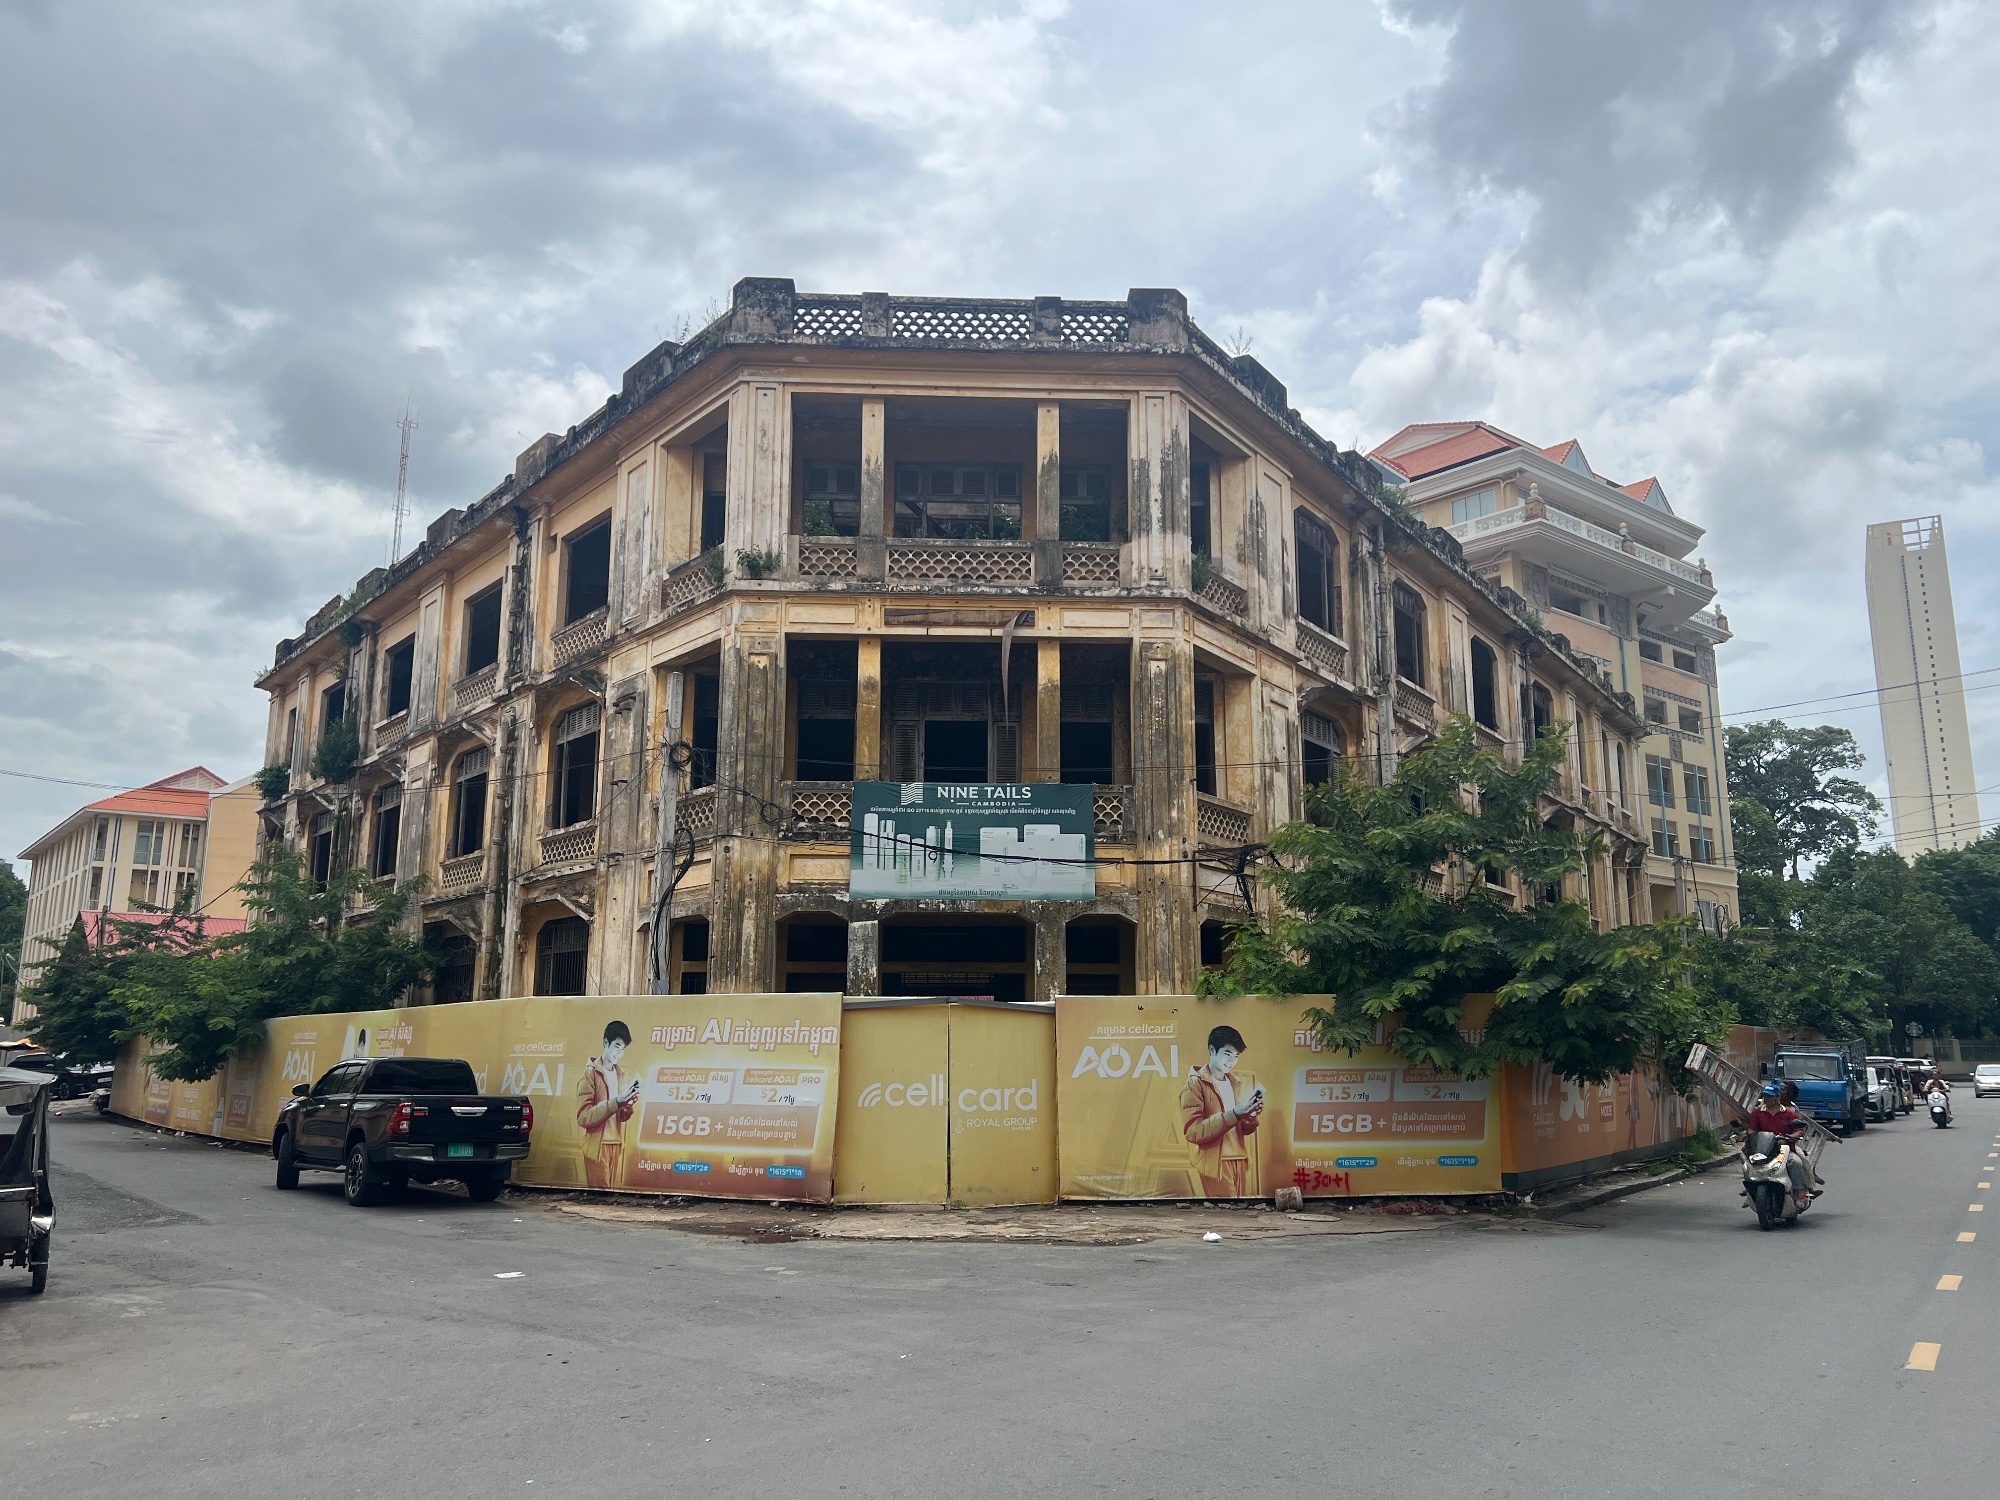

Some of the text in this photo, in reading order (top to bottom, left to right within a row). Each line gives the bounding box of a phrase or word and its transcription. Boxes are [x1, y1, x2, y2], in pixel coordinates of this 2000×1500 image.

[938, 783, 1032, 802] NINE TAILS
[699, 1017, 732, 1043] AI
[1128, 1023, 1174, 1034] cellcard
[526, 1041, 564, 1052] cellcard
[659, 1073, 685, 1082] cellcard
[746, 1074, 773, 1084] cellcard
[802, 1076, 821, 1084] PRO
[1308, 1075, 1337, 1083] cellcard
[667, 1086, 696, 1101] $1.5
[761, 1088, 778, 1103] $2
[1320, 1086, 1351, 1101] $1.5
[1424, 1085, 1442, 1099] $2
[1600, 1104, 1613, 1117] MODE
[656, 1114, 711, 1136] 15GB
[966, 1117, 1038, 1128] ROYAL GROUP
[1310, 1114, 1373, 1133] 15GB
[1293, 1167, 1350, 1193] #30+1
